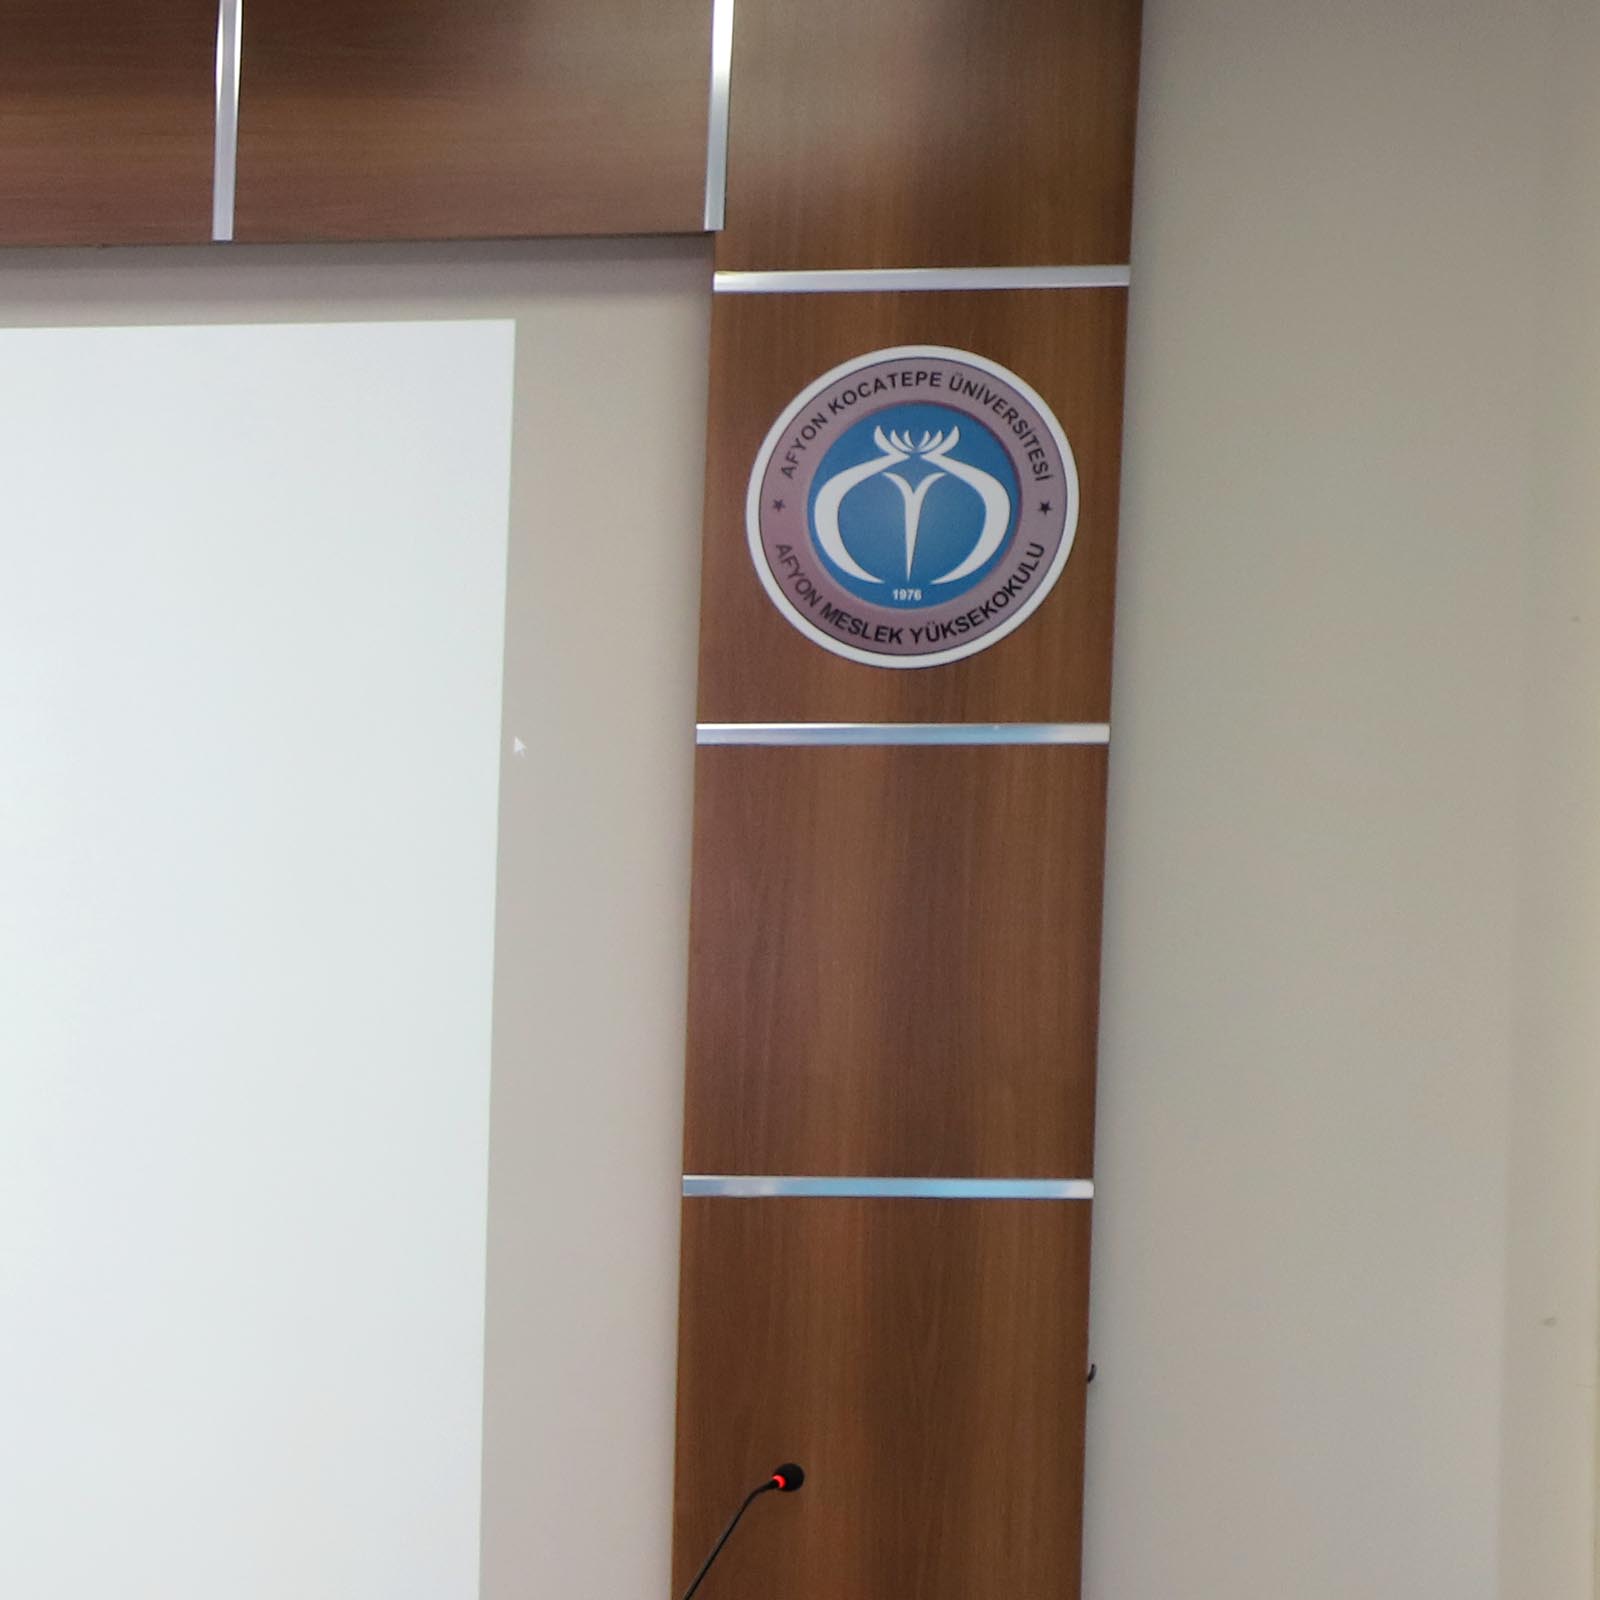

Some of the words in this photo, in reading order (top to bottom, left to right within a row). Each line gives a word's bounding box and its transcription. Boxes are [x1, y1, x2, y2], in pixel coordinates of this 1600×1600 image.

[781, 412, 829, 480] AFYON
[828, 371, 943, 415] KOCATEPE
[949, 373, 1055, 482] ÜNİVERSİTESİ
[776, 543, 823, 608] AFYON
[822, 602, 903, 645] MESLEK
[909, 542, 1046, 645] YÜKSEKOKULU
